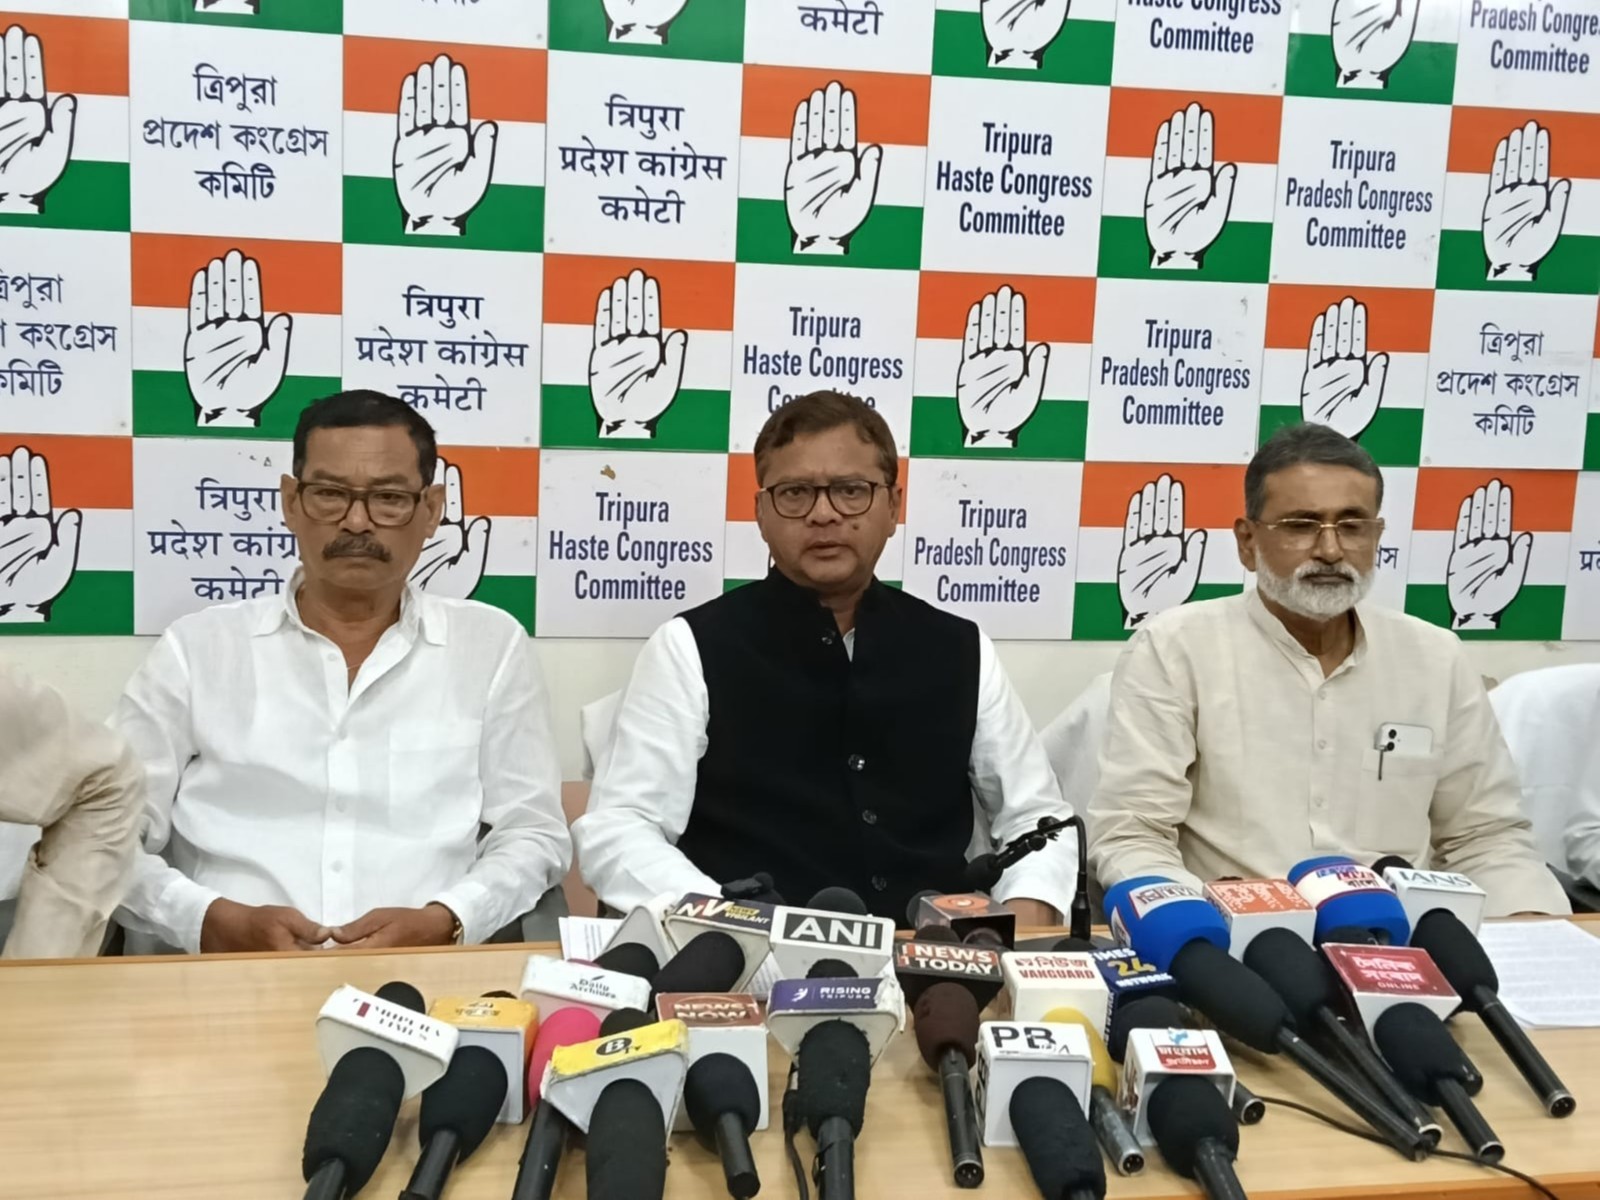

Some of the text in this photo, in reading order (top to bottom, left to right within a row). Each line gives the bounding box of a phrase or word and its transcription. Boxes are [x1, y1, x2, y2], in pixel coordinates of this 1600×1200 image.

[1149, 16, 1254, 54] Committee
[1470, 0, 1600, 42] Pradesh Congre
[1490, 38, 1590, 74] Committee
[192, 63, 278, 113] ত্রিপুরা
[604, 93, 685, 140] त्रिपुरा
[142, 118, 329, 157] প্রদেশ কংগ্রেস
[982, 121, 1053, 163] Tripura
[558, 136, 728, 181] प्रदेश कांग्रेस
[1330, 139, 1396, 179] Tripura
[194, 161, 277, 200] কমিটি
[936, 160, 1093, 203] Haste Congress
[1285, 177, 1433, 218] Pradesh Congress
[598, 186, 686, 224] कमेटी
[959, 202, 1065, 237] Committee
[1306, 217, 1406, 250] Committee
[402, 285, 485, 328] त्रिपुरा
[789, 306, 861, 342] Tripura
[15, 321, 118, 352] কংগ্রেস
[355, 326, 529, 368] प्रदेश कांग्रेस
[1145, 319, 1213, 356] Tripura
[1480, 322, 1545, 362] ত্রিপুরা
[743, 345, 903, 385] Haste Congress
[1100, 356, 1251, 396] Pradesh Congress
[1436, 369, 1580, 398] প্রদেশ কংগ্রেস
[1122, 396, 1224, 426] Committee
[1473, 404, 1536, 436] কমিটি
[595, 491, 669, 525] Tripura
[958, 499, 1027, 536] Tripura
[147, 519, 223, 560] प्रदेश
[549, 530, 713, 568] Haste Congress
[914, 536, 1066, 574] Pradesh Congress
[574, 573, 686, 600] Committee
[936, 575, 1040, 604] Committee
[1399, 870, 1473, 887] IANS
[789, 916, 877, 948] ANI
[914, 944, 993, 964] NEWS
[915, 957, 993, 975] TODAY
[1107, 957, 1157, 977] 24
[819, 986, 872, 995] RISING
[1018, 969, 1096, 980] VANGUARD
[1376, 981, 1421, 990] ONLINE
[676, 1010, 747, 1020] NOW
